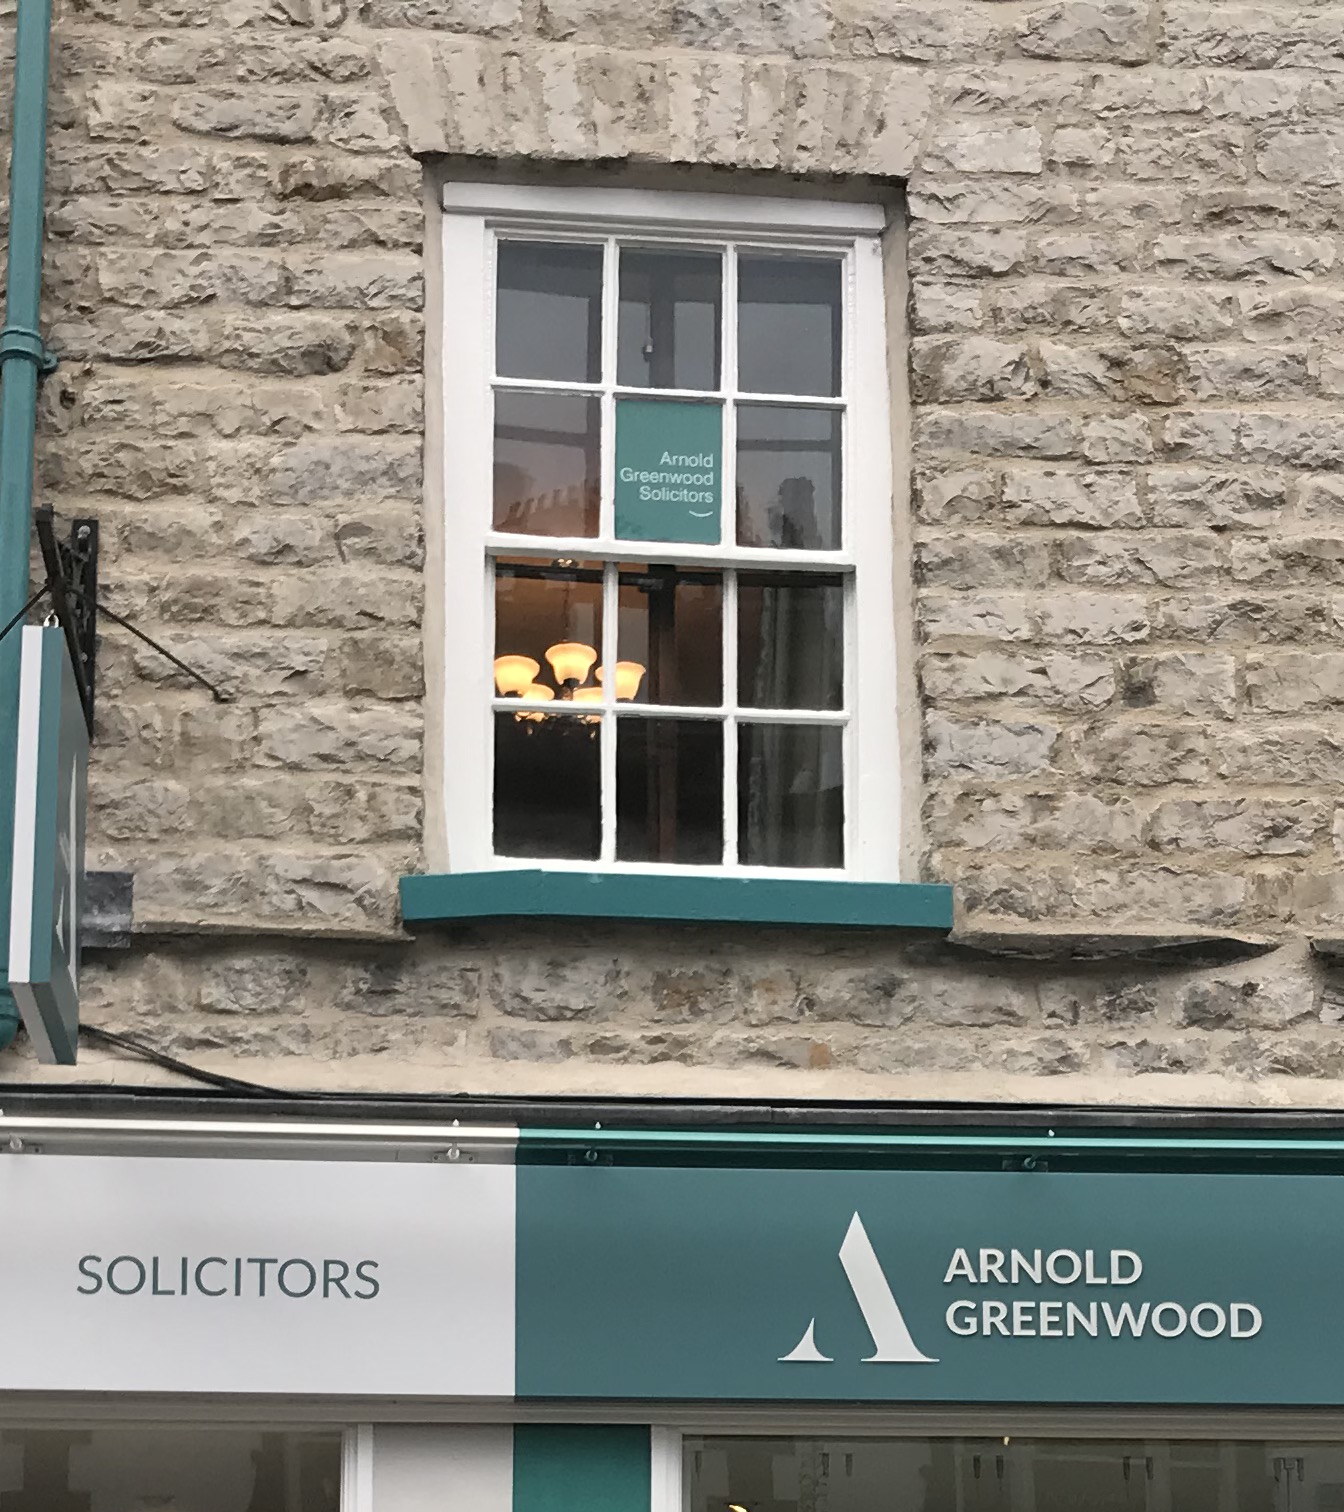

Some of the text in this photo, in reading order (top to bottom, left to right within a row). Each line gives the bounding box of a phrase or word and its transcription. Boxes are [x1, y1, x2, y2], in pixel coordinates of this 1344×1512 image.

[659, 451, 714, 468] Arnold
[619, 467, 714, 486] Greenwood
[639, 486, 714, 503] Solicitors
[76, 1254, 380, 1300] SOLICITORS
[943, 1247, 1143, 1285] ARNOLD
[945, 1299, 1263, 1339] GREENWOOD
